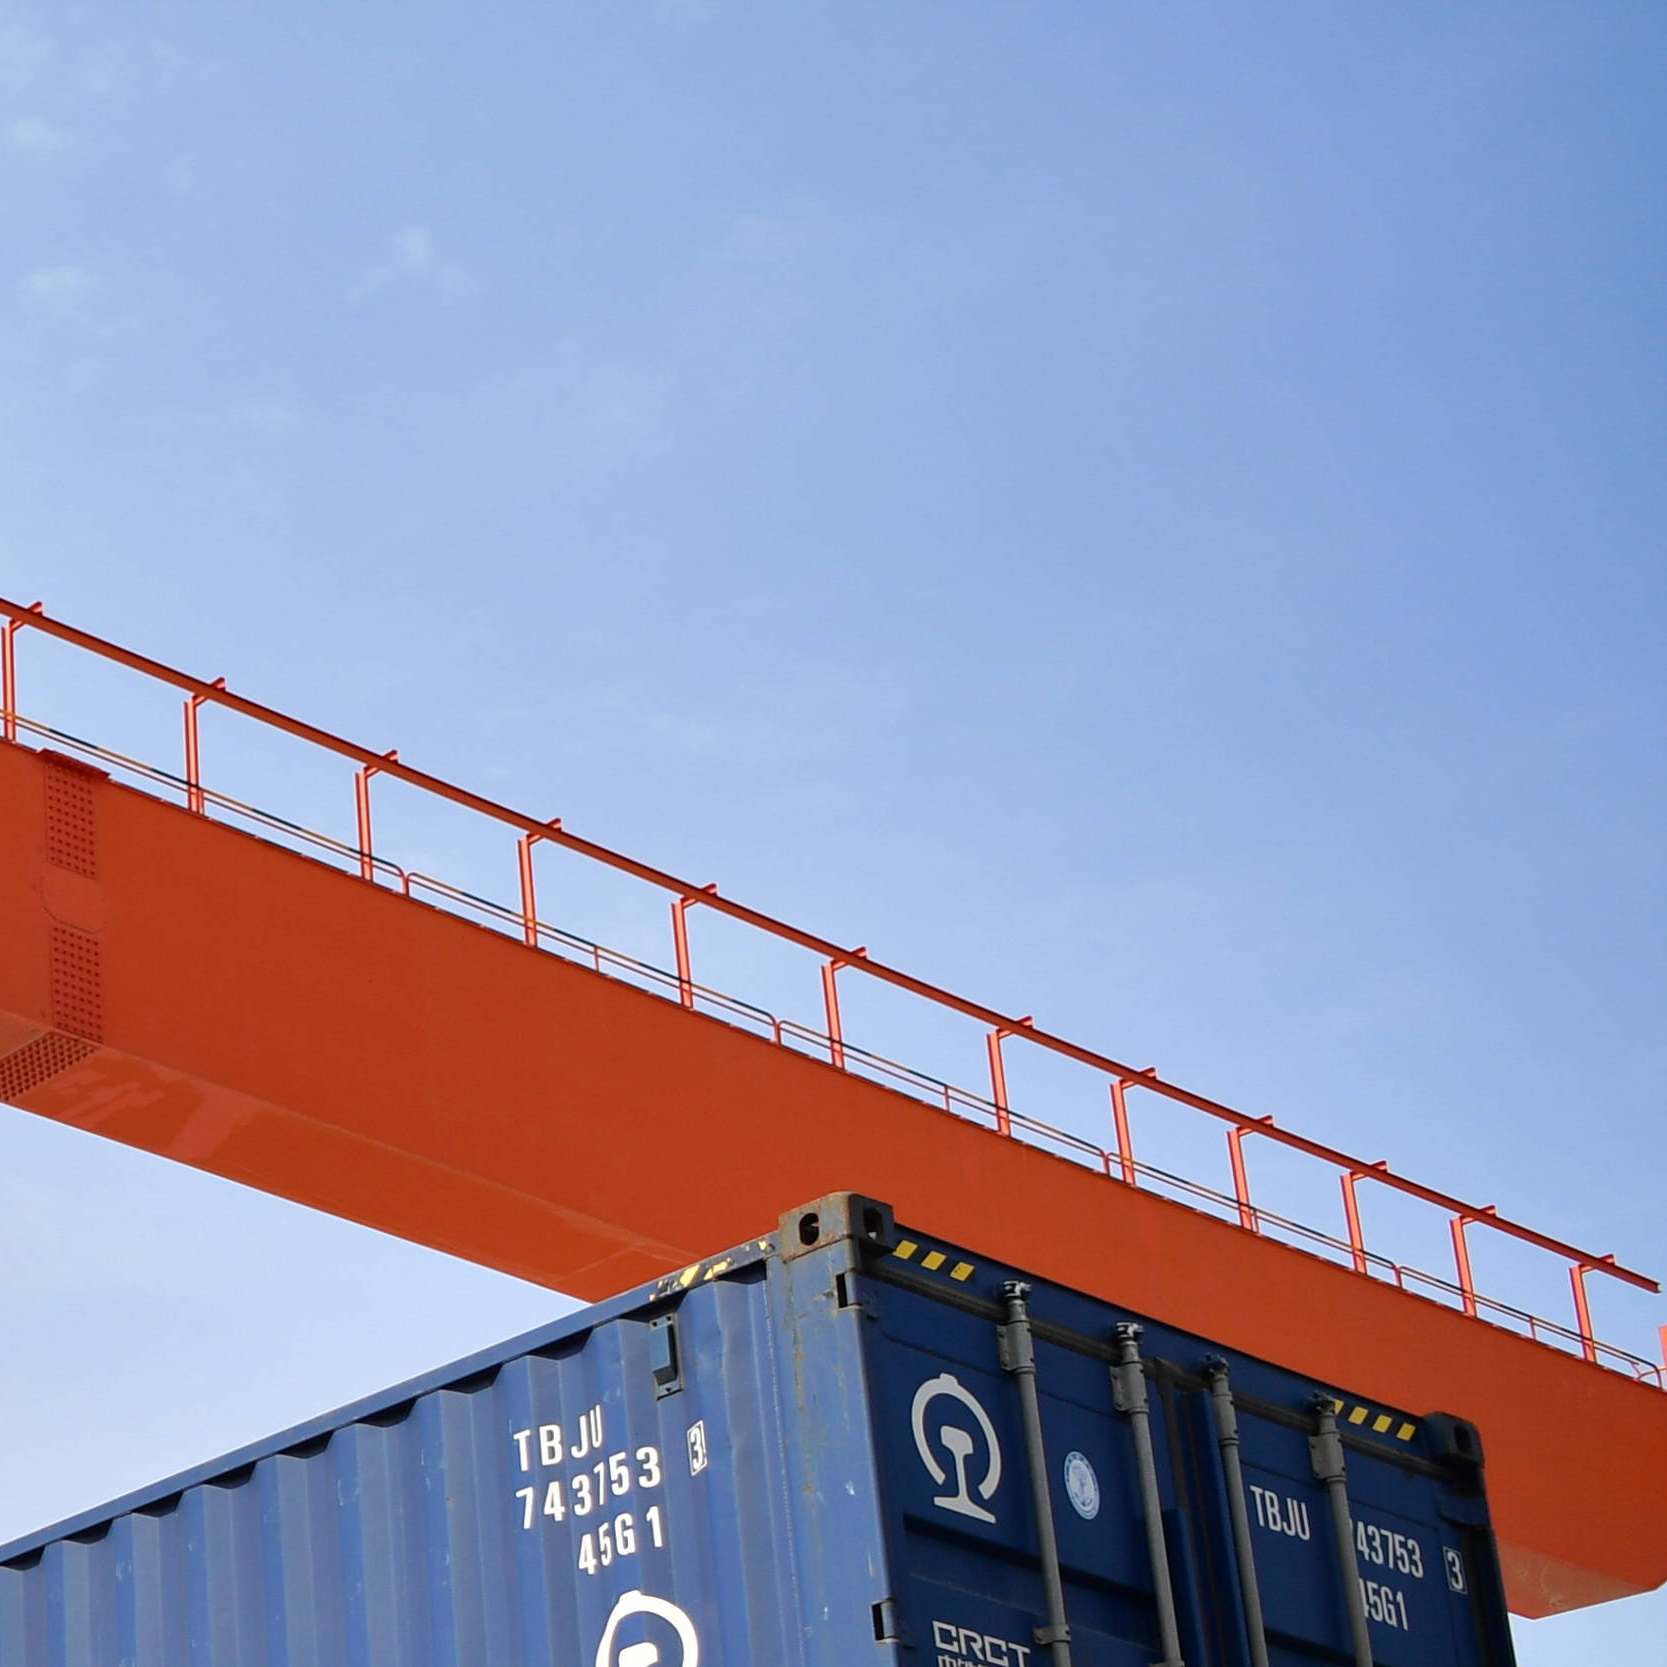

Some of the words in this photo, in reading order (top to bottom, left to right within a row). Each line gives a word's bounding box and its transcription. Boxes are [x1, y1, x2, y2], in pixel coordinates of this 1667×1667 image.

[513, 1404, 603, 1472] TBJU
[515, 1446, 661, 1530] 743753
[578, 1506, 663, 1575] 45G1
[1249, 1485, 1310, 1541] TBJU
[1350, 1518, 1424, 1578] 43753
[1447, 1551, 1464, 1590] 3
